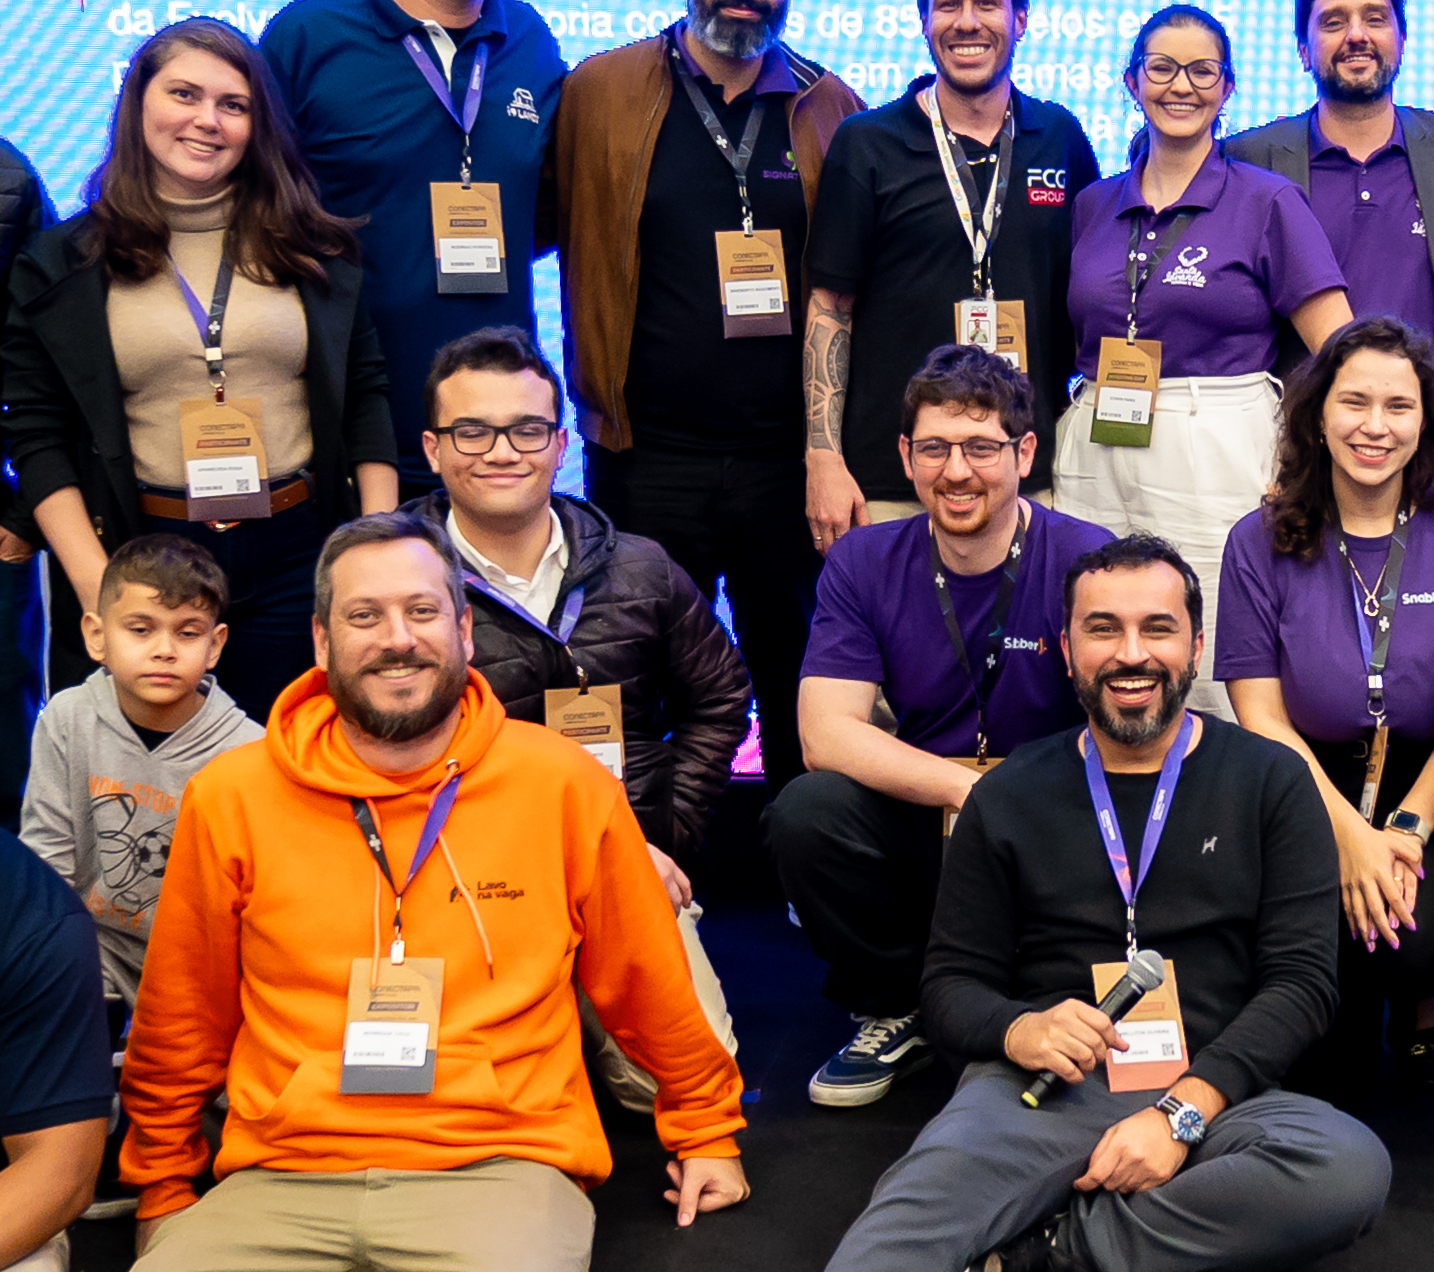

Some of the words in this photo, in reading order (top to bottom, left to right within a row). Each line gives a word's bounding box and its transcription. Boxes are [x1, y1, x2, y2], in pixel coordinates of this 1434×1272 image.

[107, 1, 155, 36] da
[817, 5, 863, 38] de
[844, 61, 901, 89] em
[477, 881, 507, 891] Lavo
[477, 892, 492, 901] na
[496, 890, 525, 901] vaga
